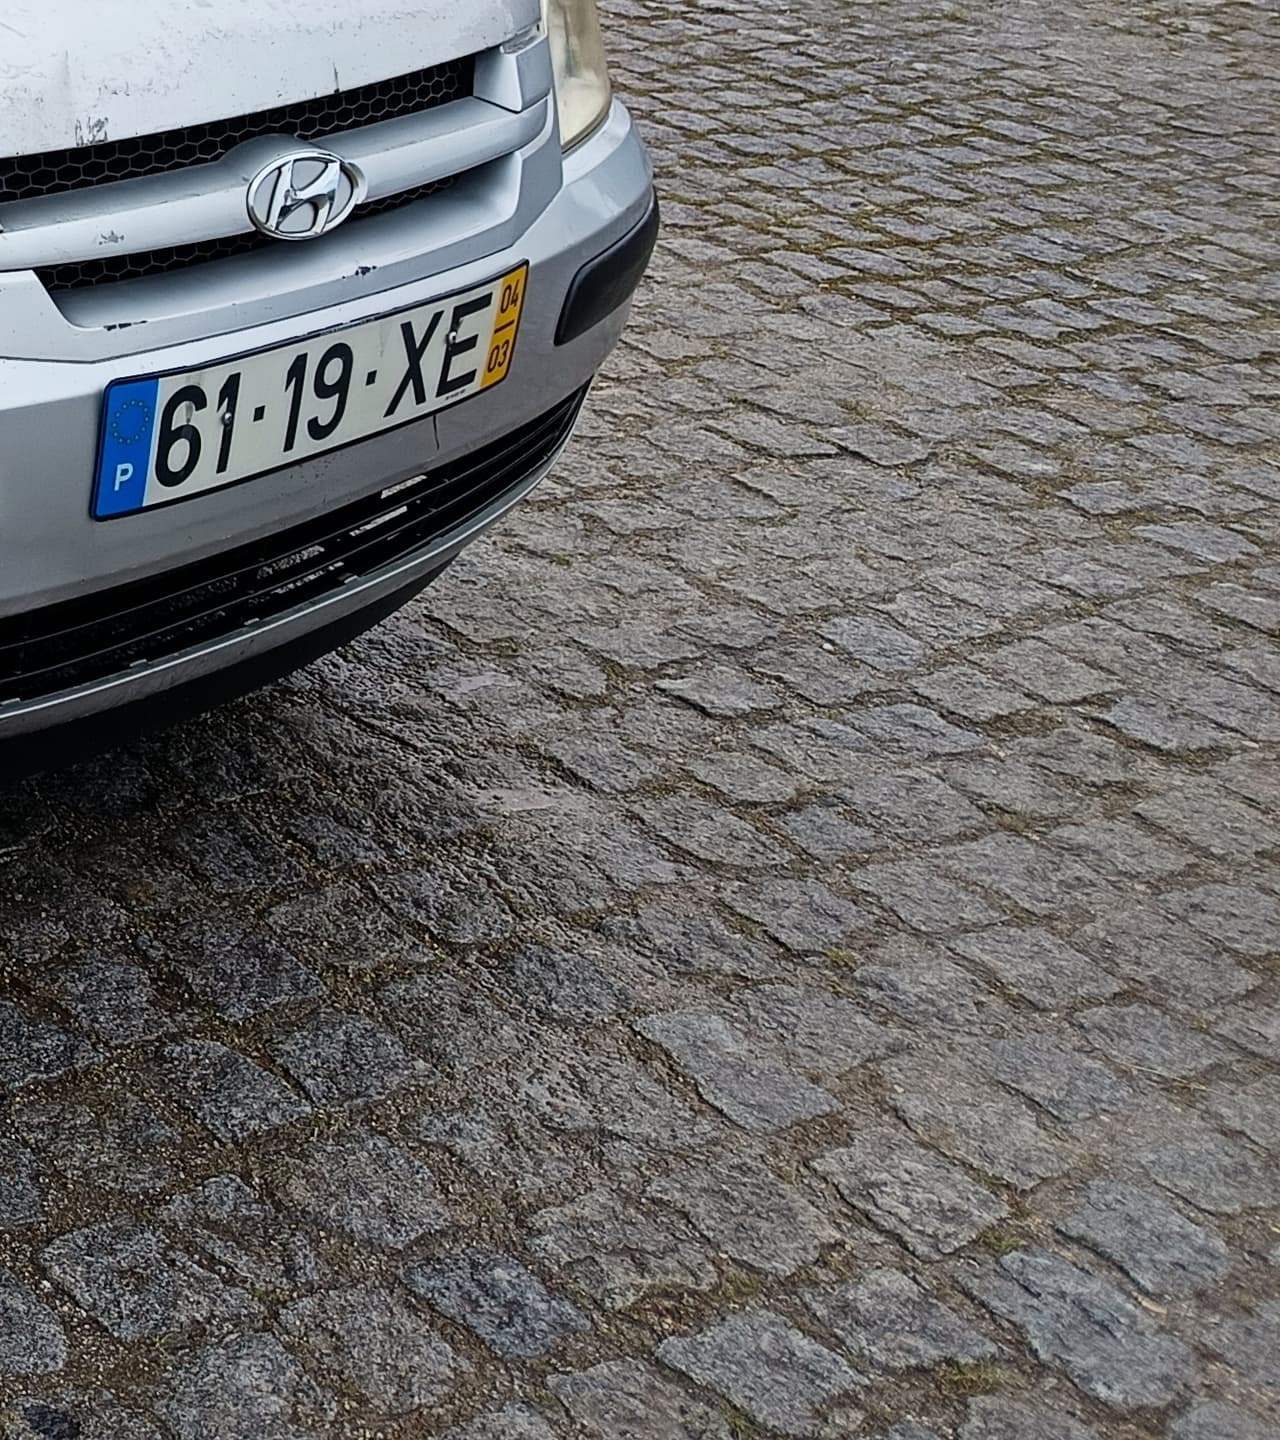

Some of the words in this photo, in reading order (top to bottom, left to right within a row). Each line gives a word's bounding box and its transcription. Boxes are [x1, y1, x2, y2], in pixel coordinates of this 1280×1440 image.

[500, 279, 520, 314] 04
[487, 339, 510, 373] 03
[114, 462, 134, 492] P
